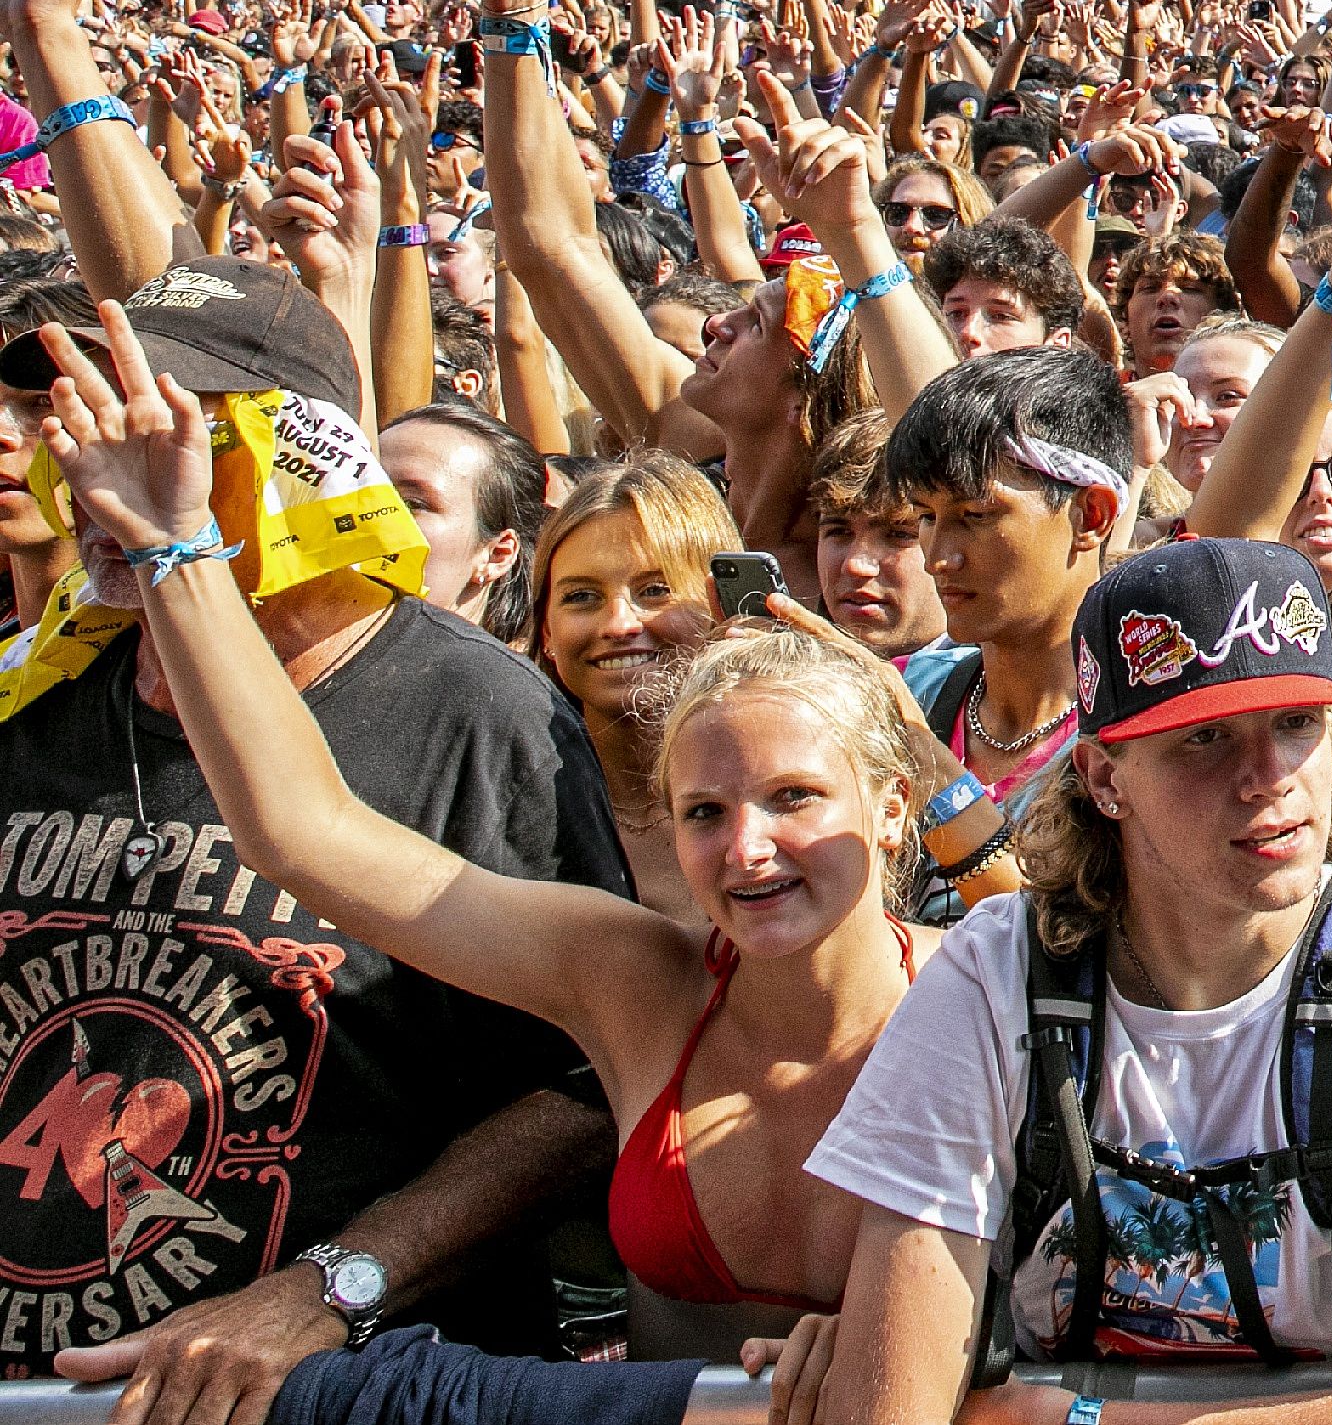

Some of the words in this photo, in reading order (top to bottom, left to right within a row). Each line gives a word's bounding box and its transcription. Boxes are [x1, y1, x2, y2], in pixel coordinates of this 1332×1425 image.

[274, 418, 354, 469] AUGUST
[351, 462, 368, 480] 1
[273, 451, 328, 487] 2021
[358, 505, 400, 522] TOYOTA
[1125, 620, 1149, 644] WORLD
[1138, 623, 1162, 646] SERIES
[0, 811, 134, 902] TOM
[112, 908, 145, 931] AND
[147, 912, 176, 933] THE
[0, 932, 297, 1112] EARTBREAKERS
[0, 1198, 247, 1352] ERSARY
